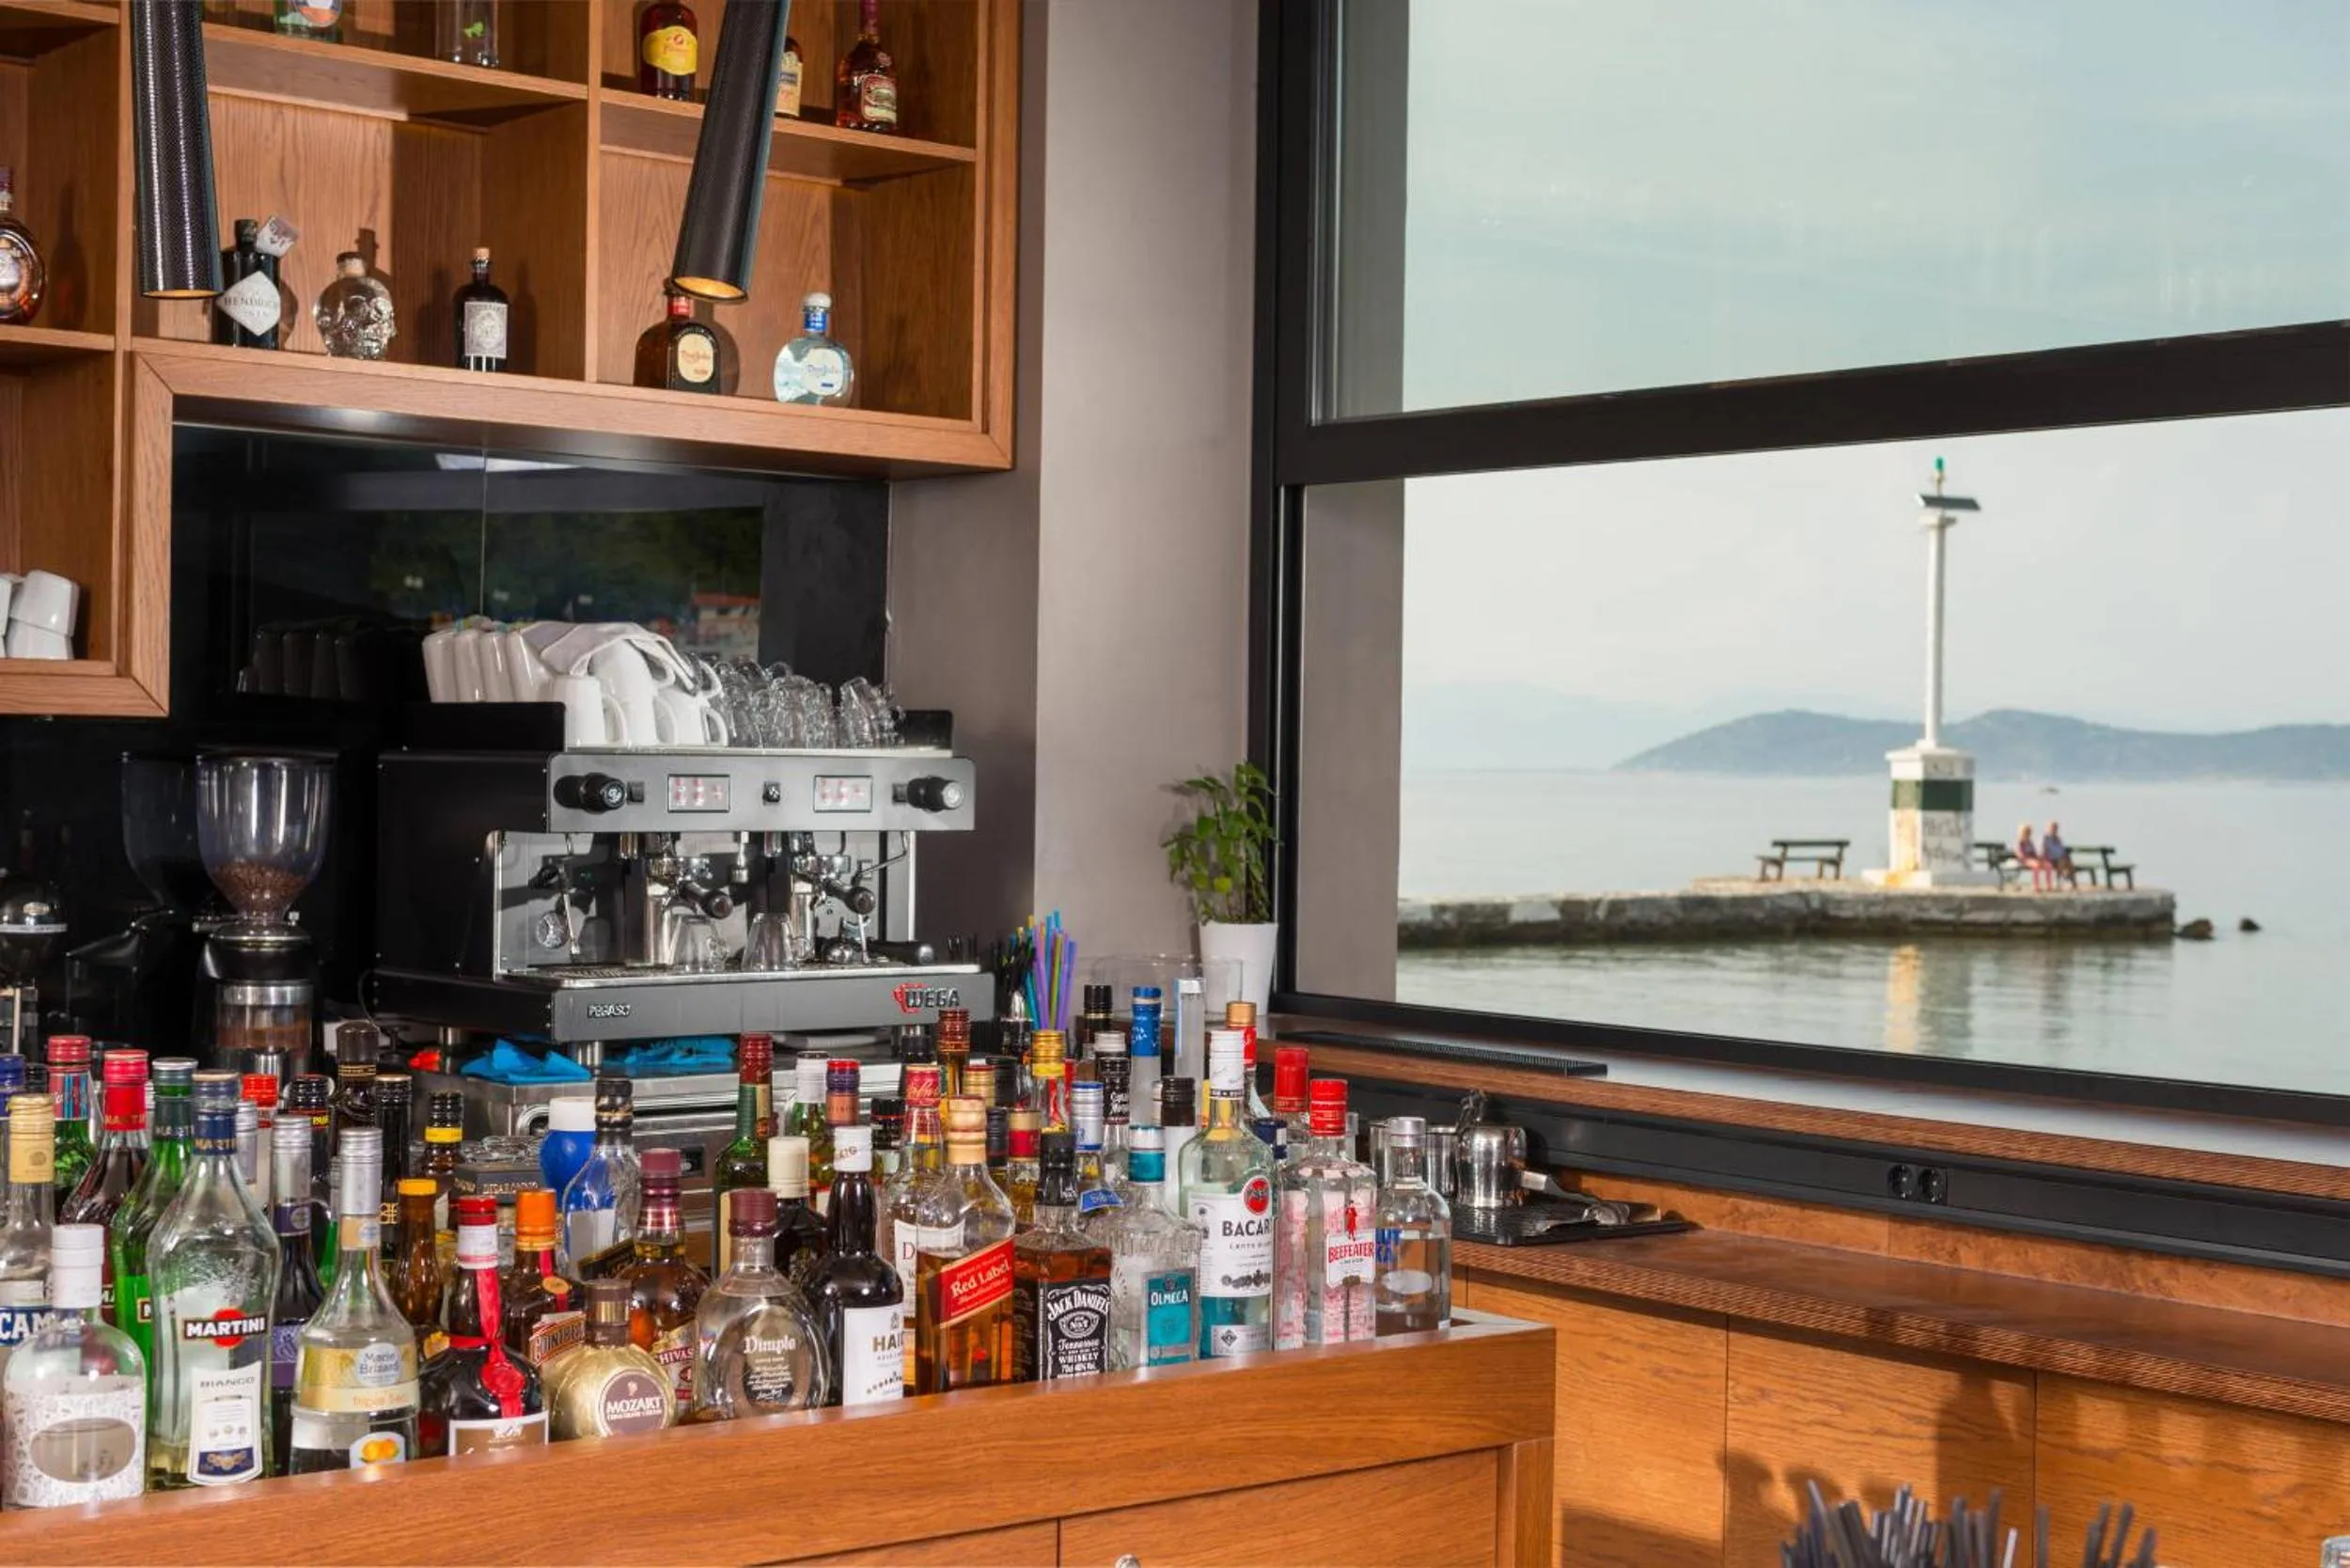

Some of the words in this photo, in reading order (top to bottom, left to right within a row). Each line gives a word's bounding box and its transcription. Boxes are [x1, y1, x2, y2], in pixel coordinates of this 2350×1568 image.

[904, 987, 961, 1008] WEGA
[1222, 1218, 1270, 1237] BACAR
[1328, 1241, 1375, 1263] BEEFEATER
[950, 1275, 978, 1298] Red
[979, 1258, 1011, 1286] Label
[1047, 1294, 1073, 1322] JACK
[1151, 1289, 1189, 1307] OLMECA
[186, 1315, 266, 1338] MARTINI
[744, 1334, 797, 1355] Dimple
[606, 1396, 663, 1414] MOZART
